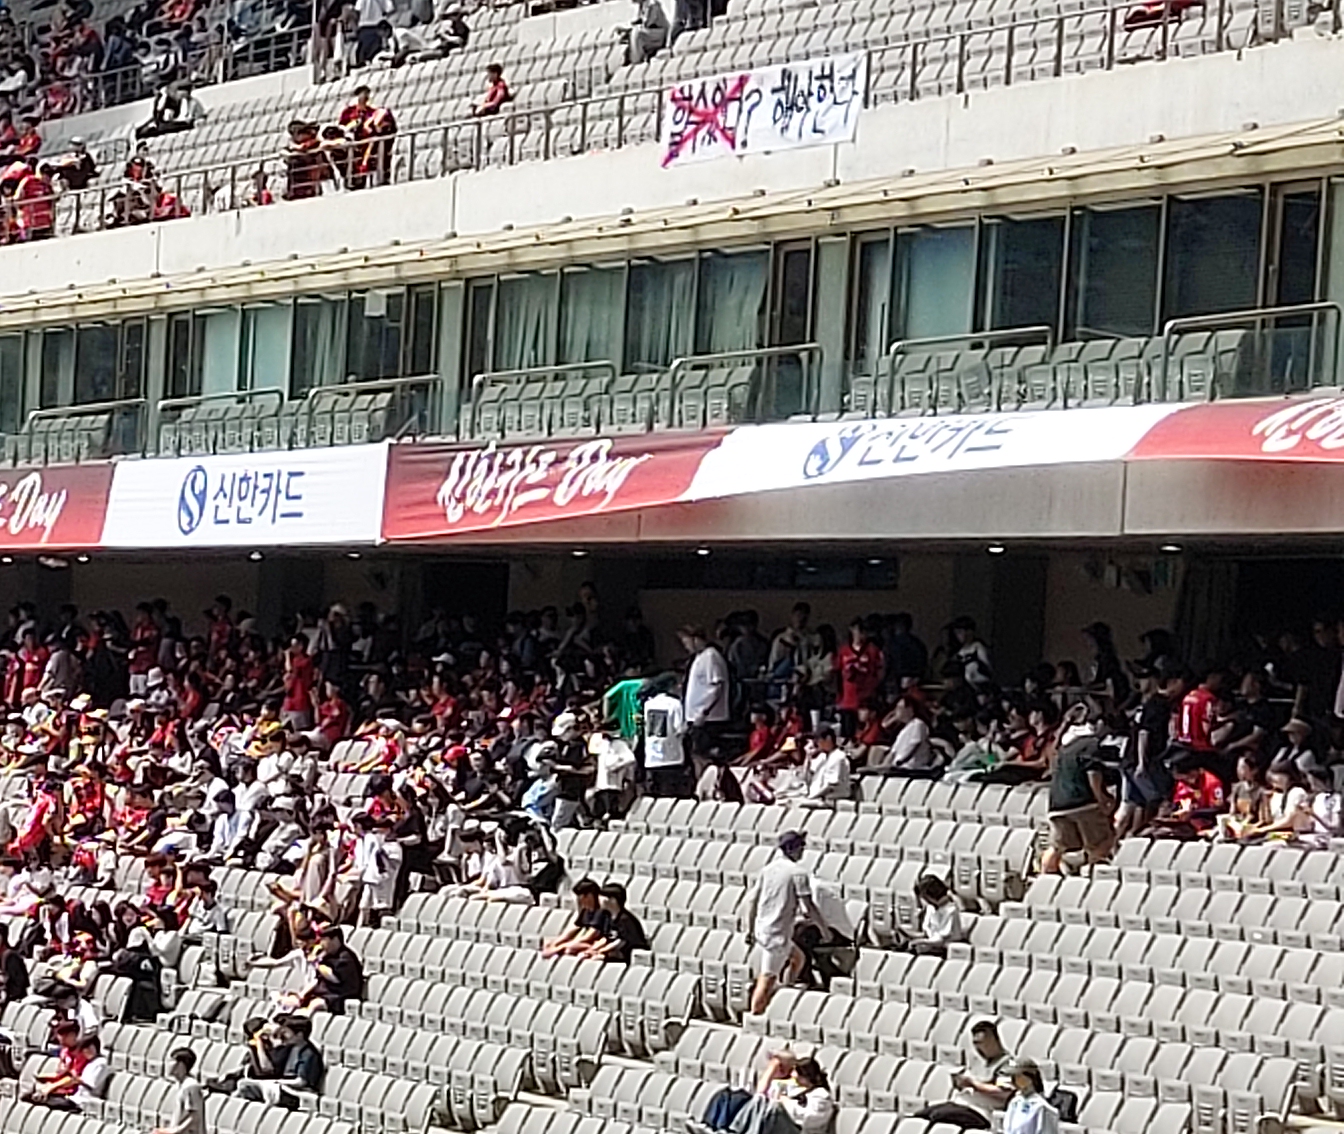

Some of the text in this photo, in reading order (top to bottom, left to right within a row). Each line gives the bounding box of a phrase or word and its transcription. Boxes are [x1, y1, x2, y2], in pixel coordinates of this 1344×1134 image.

[8, 470, 69, 544] Day
[212, 468, 306, 526] 신한카드
[550, 437, 655, 514] Day
